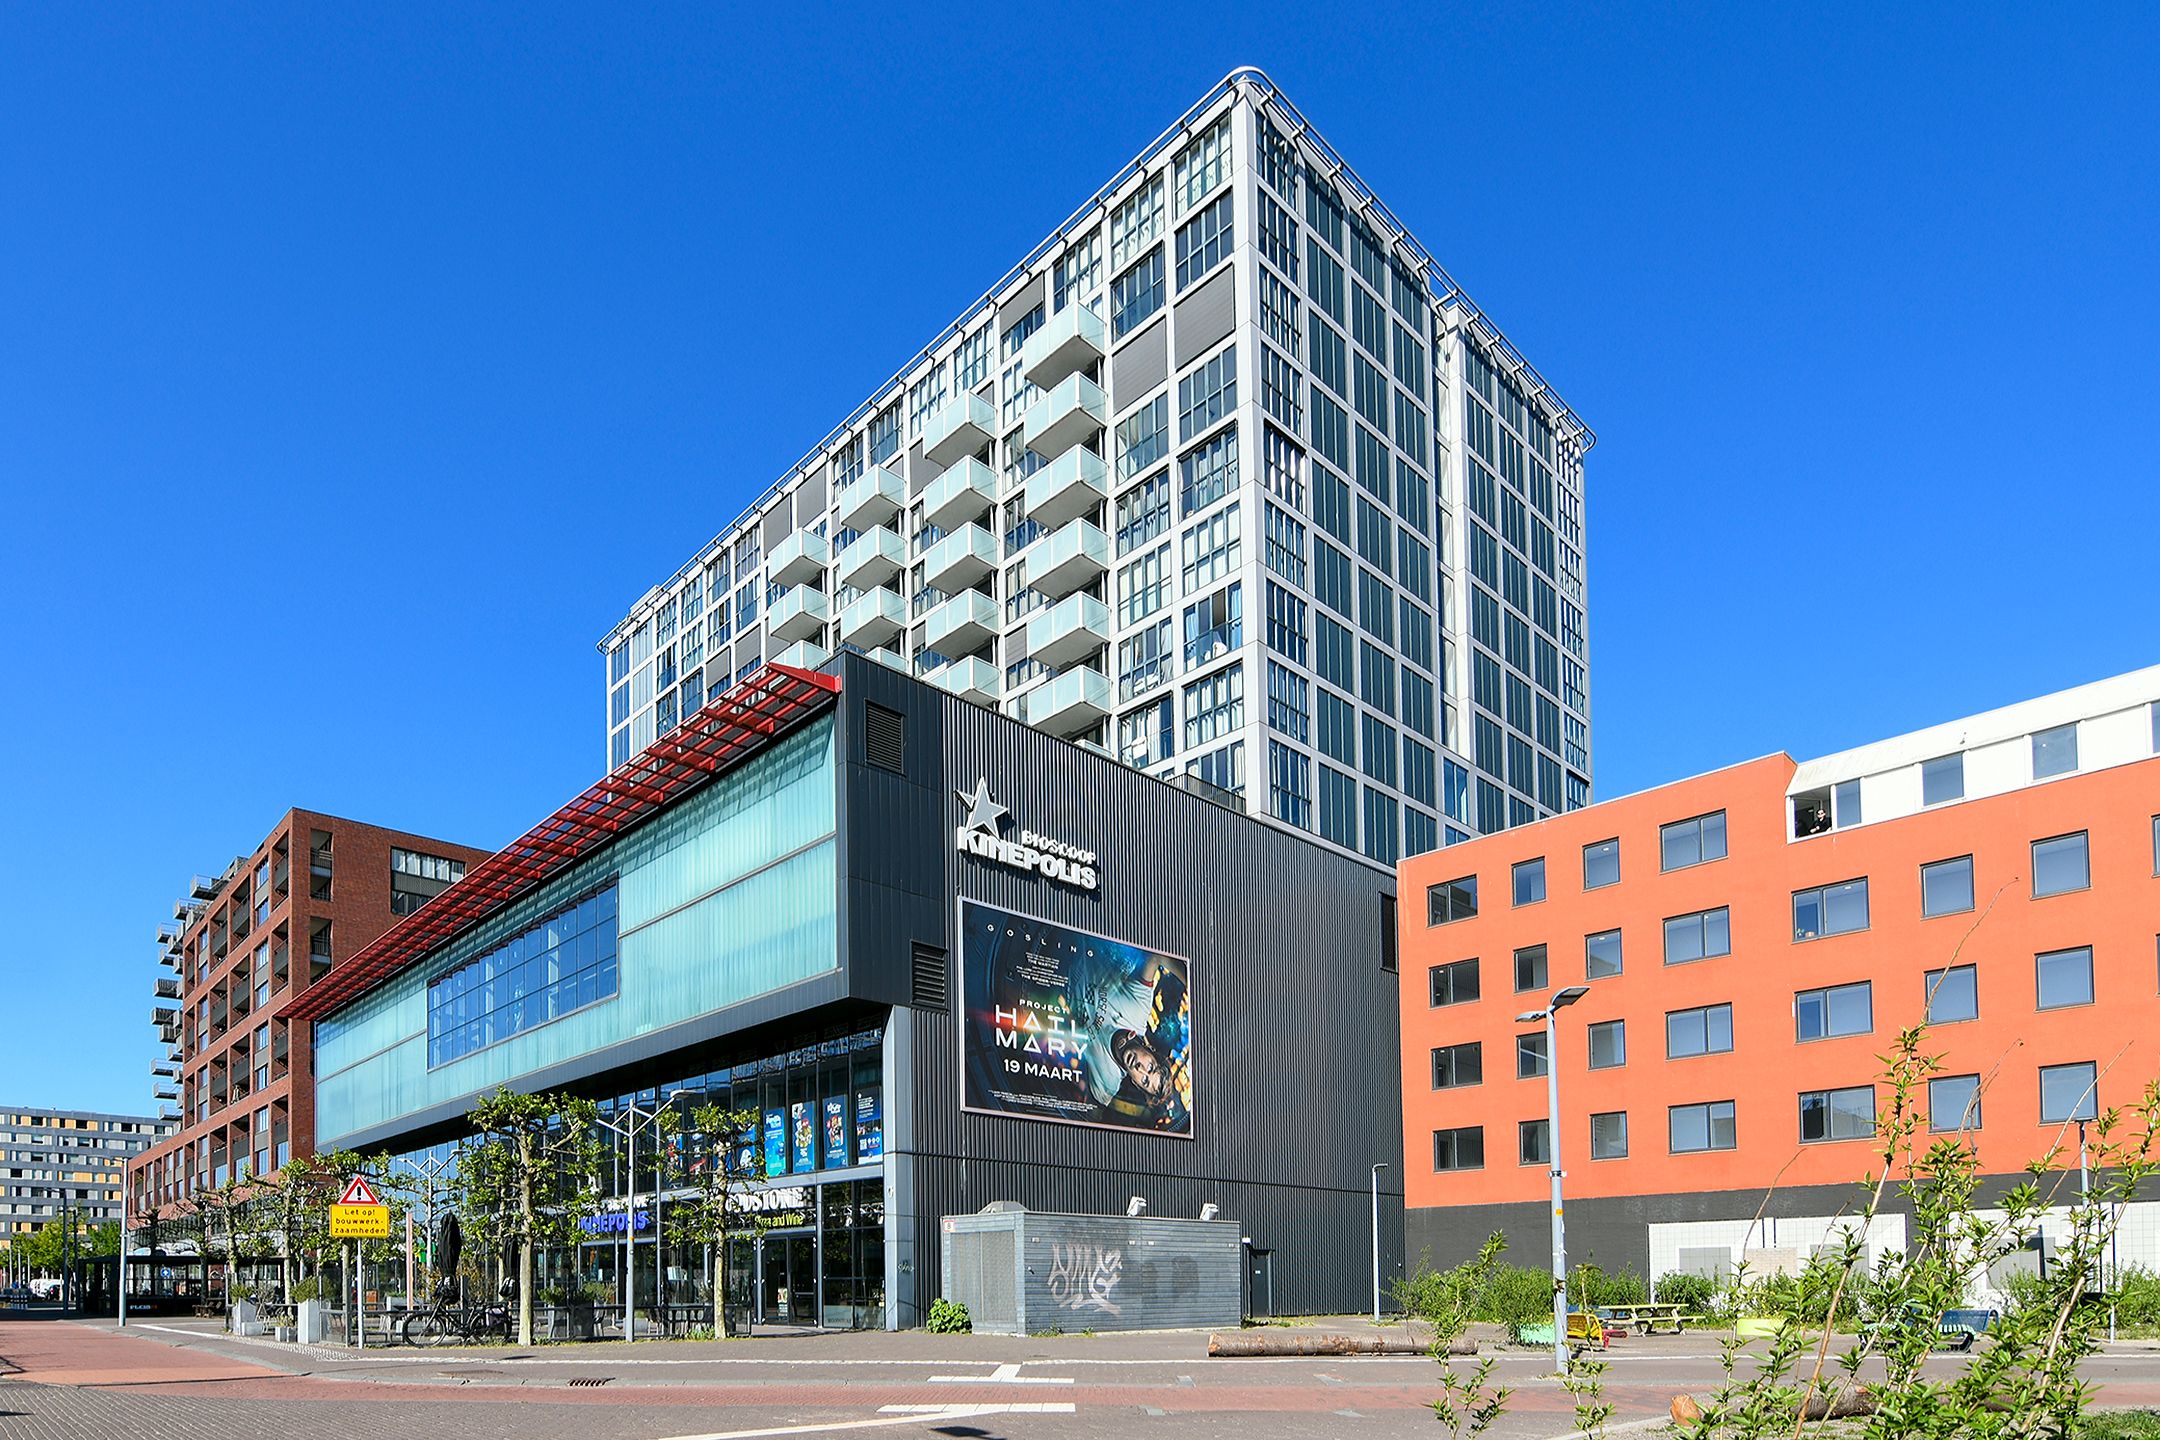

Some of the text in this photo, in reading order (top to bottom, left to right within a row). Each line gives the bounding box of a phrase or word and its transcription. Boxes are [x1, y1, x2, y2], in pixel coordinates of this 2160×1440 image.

[956, 826, 1098, 890] KINEPOLIS
[1021, 829, 1097, 865] BIOSCOOP
[986, 924, 1094, 958] GOSLING
[1019, 998, 1067, 1015] PROJECT
[995, 1004, 1089, 1040] HAIL
[995, 1026, 1088, 1061] MARY
[1003, 1058, 1083, 1083] 19 MAART
[344, 1208, 376, 1217] Let op!
[580, 1210, 650, 1234] KINEPOIS
[772, 1214, 785, 1226] and
[785, 1212, 804, 1226] Wine
[334, 1227, 386, 1235] zaamheden
